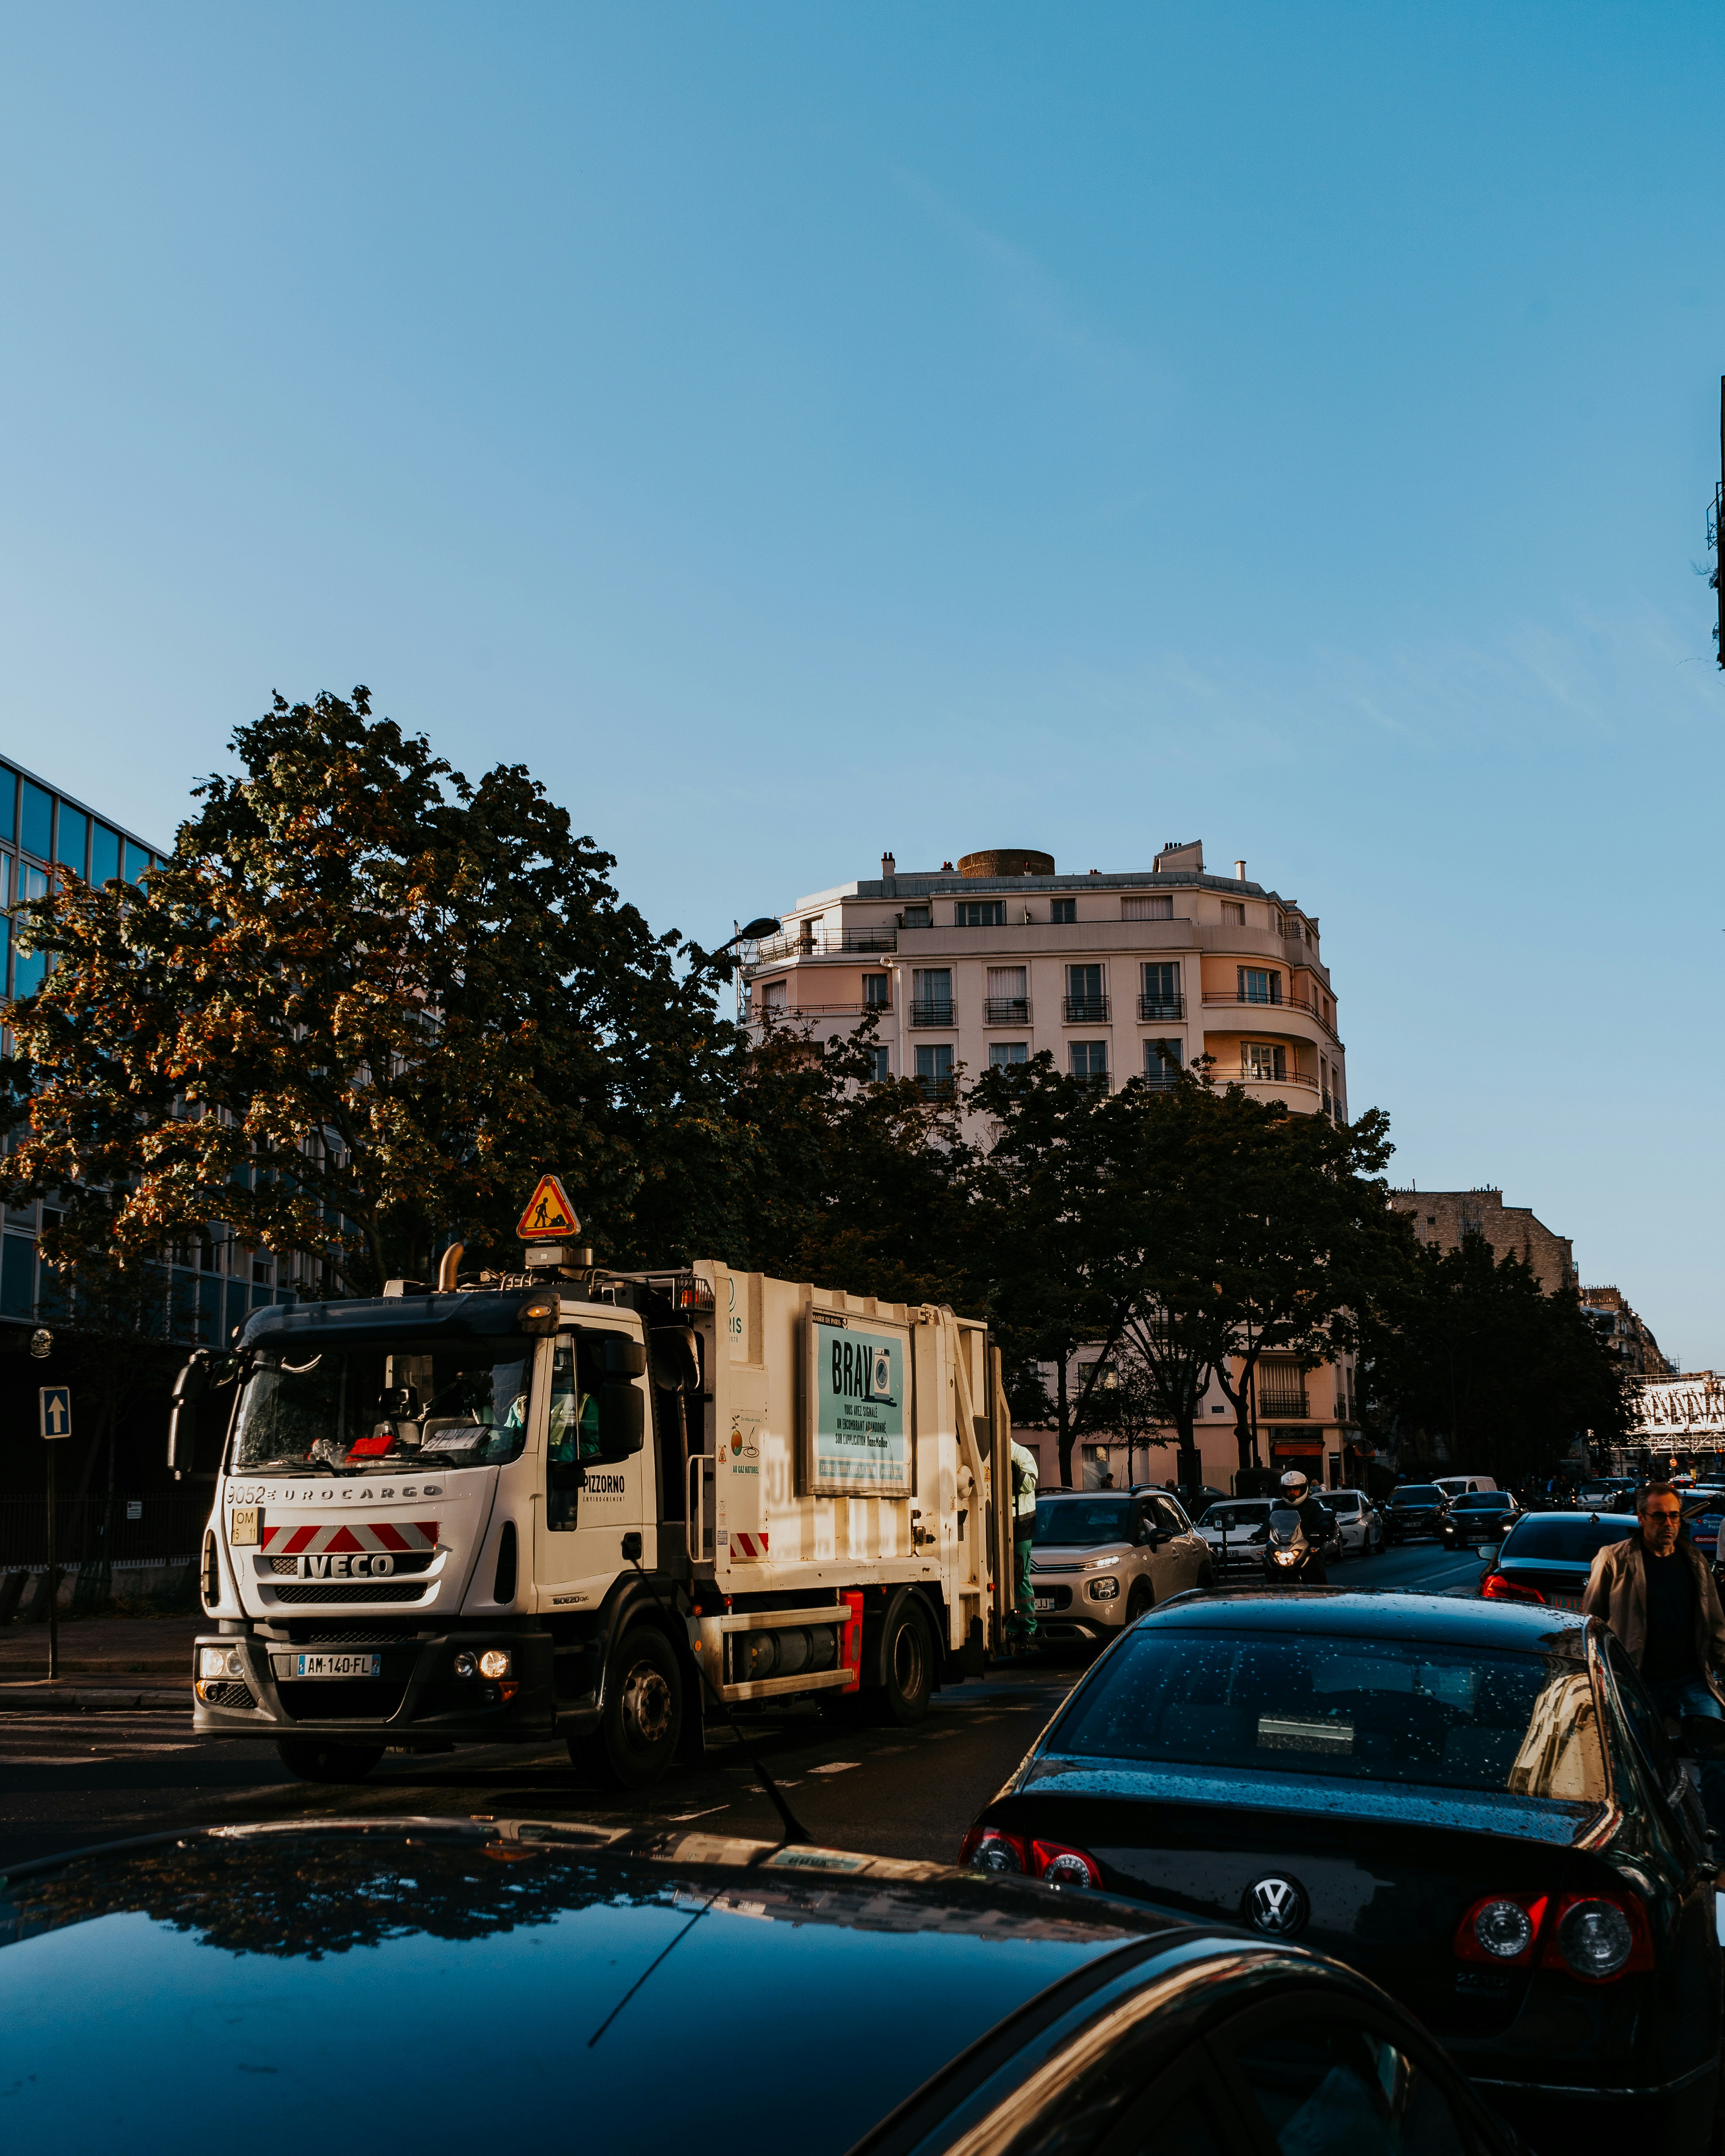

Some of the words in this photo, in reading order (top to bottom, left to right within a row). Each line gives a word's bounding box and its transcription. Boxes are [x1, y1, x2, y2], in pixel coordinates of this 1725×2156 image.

[813, 1314, 824, 1323] MAIRIE
[844, 1403, 853, 1415] VOUS
[854, 1405, 862, 1417] AVEZ
[863, 1405, 878, 1418] SIGNALÉ
[837, 1418, 842, 1429] UN
[842, 1418, 864, 1431] ENCOMBRANT
[865, 1420, 886, 1433] ABANDONNÉ
[843, 1434, 865, 1446] L'APPLICATION
[867, 1435, 888, 1448] DansMaRue
[583, 1475, 625, 1493] PIZZORNO
[227, 1486, 265, 1504] 9052
[267, 1485, 437, 1501] EUROCARGO
[237, 1512, 254, 1524] OM
[297, 1555, 394, 1579] IVECO
[308, 1657, 369, 1673] AM-140-FL
